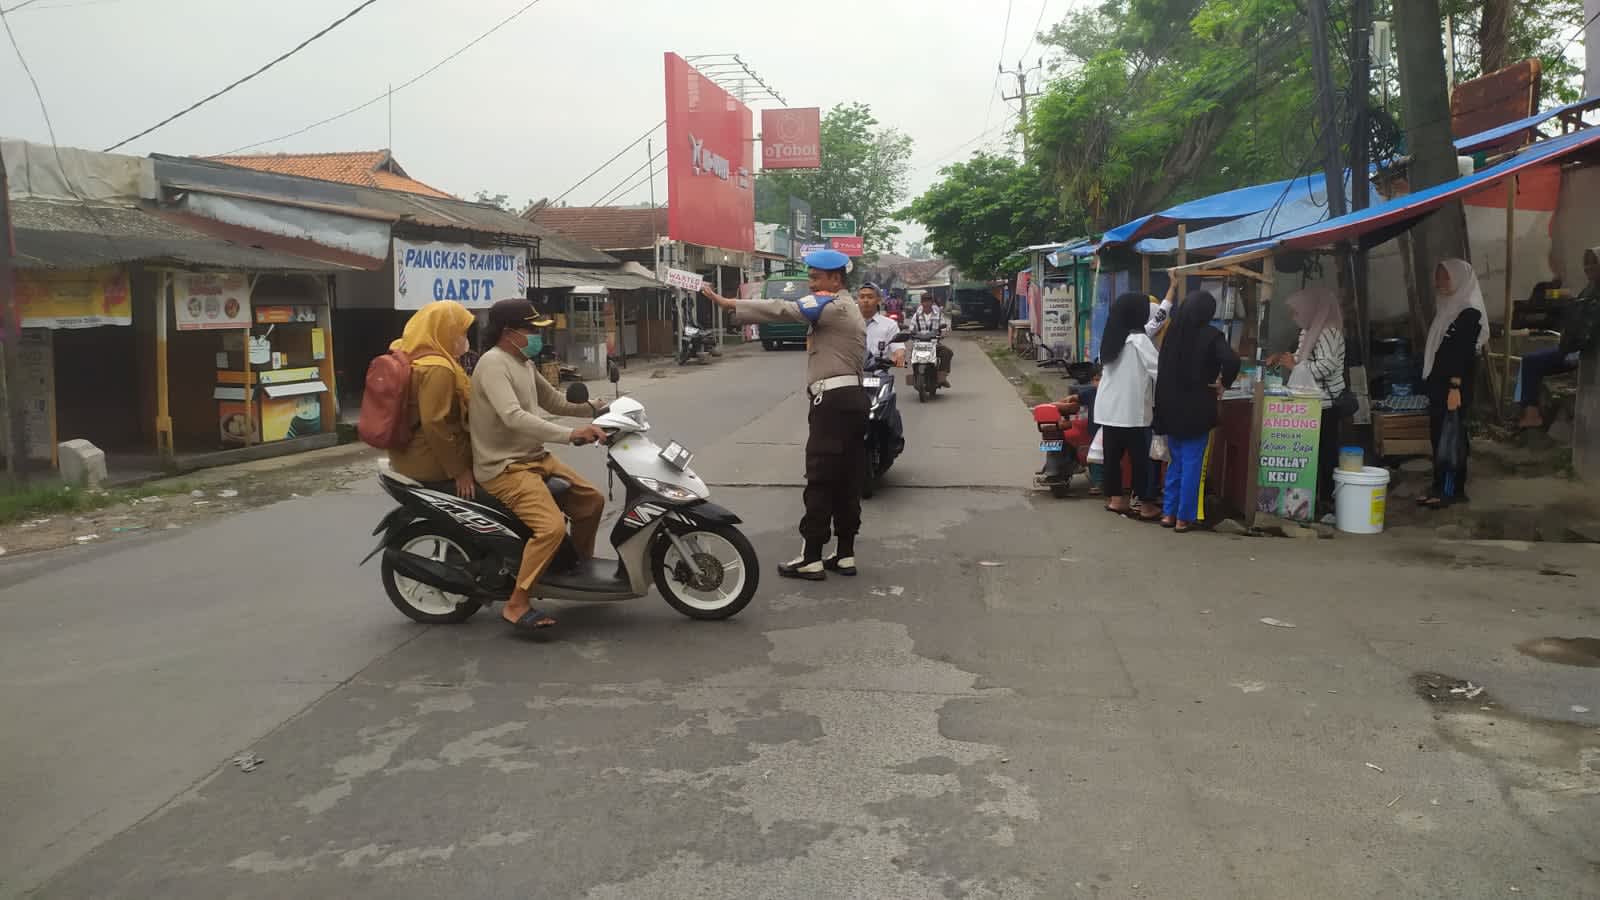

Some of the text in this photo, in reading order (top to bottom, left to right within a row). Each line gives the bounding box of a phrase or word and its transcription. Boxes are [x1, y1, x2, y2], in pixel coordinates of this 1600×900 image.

[406, 249, 515, 271] PANGKAS RAMBUT
[434, 278, 494, 301] GARUT
[1268, 403, 1307, 414] PUKIS
[1263, 417, 1318, 429] ANDUNG
[1260, 456, 1308, 469] COKLAT
[1267, 471, 1297, 482] KEJU
